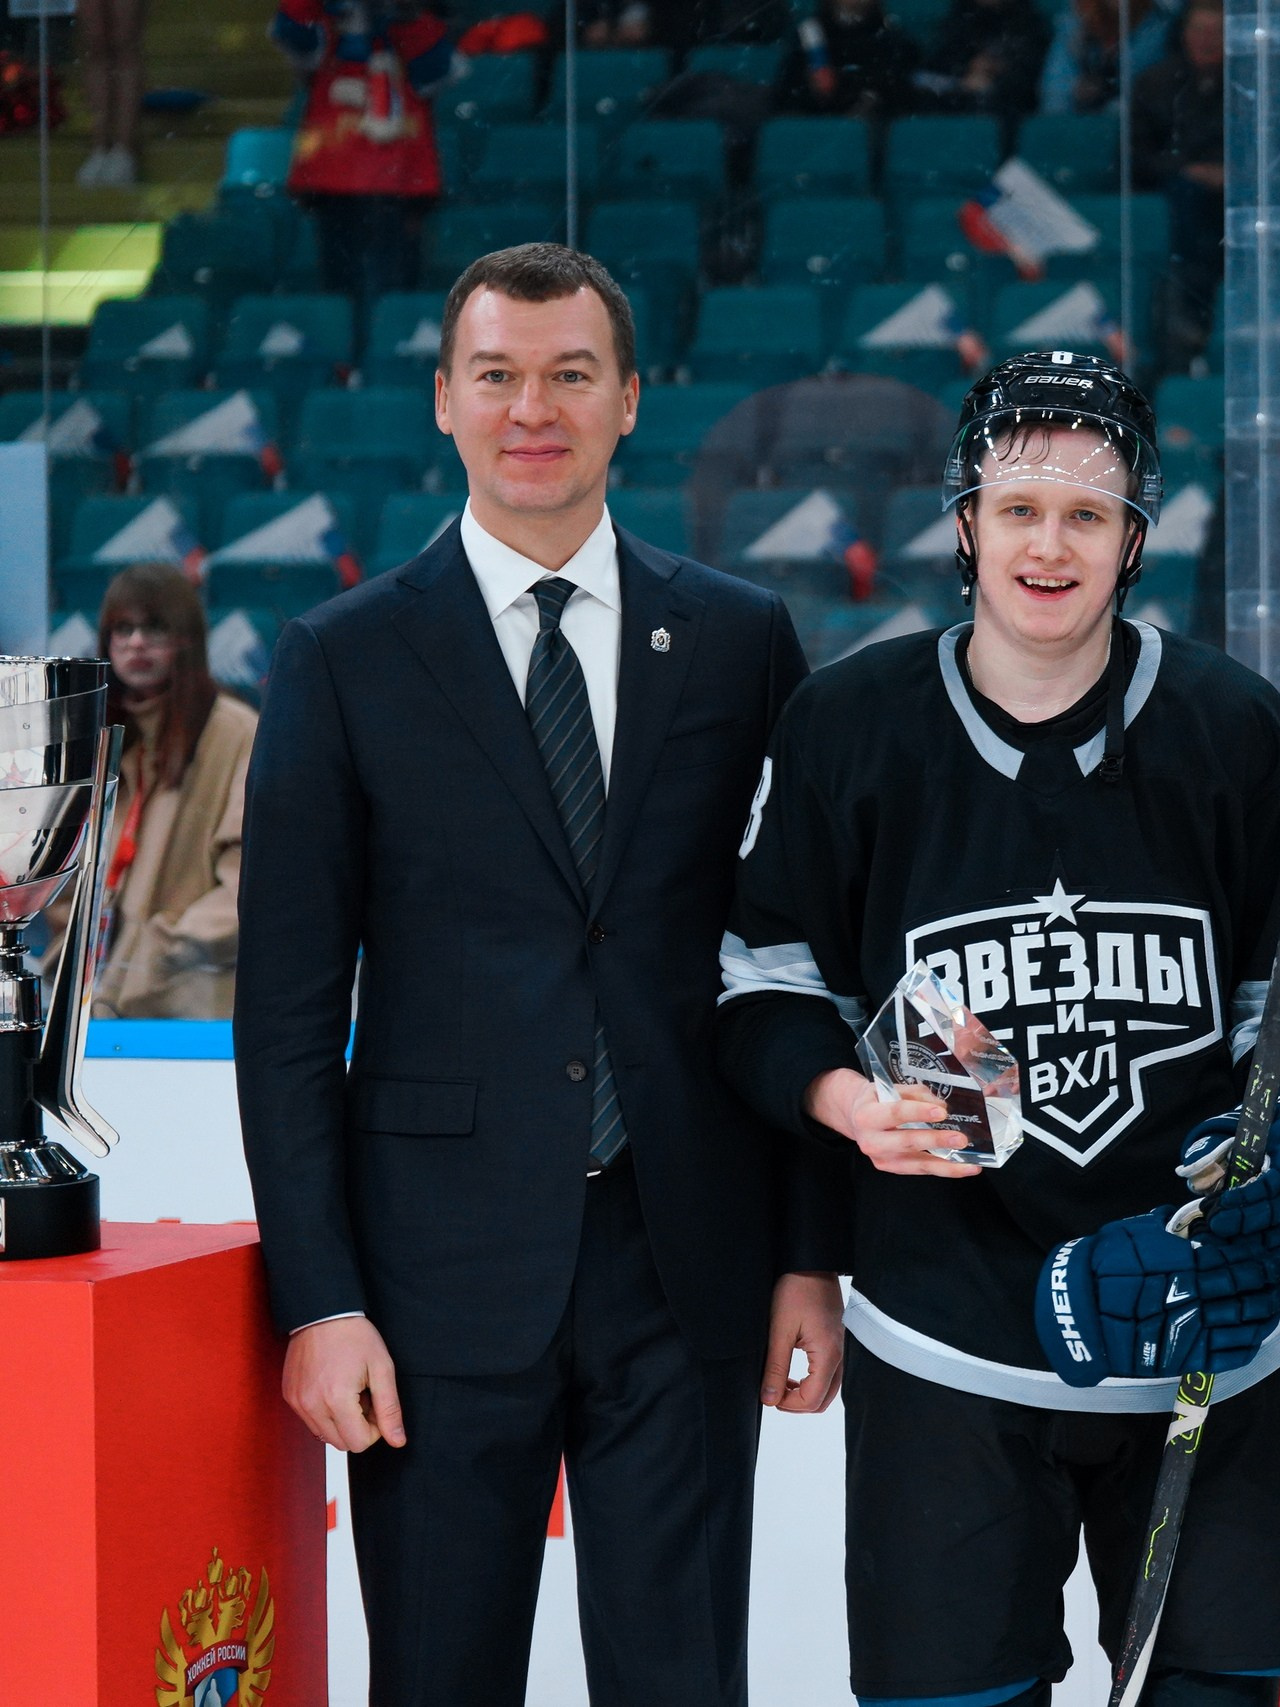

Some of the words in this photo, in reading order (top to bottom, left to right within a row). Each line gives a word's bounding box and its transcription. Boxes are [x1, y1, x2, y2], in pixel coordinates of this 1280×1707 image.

[1024, 375, 1094, 389] BAUER
[926, 921, 1202, 1014] ЗВЁЗДЫ
[1056, 1003, 1085, 1034] И
[1028, 1042, 1118, 1103] ВХЛ
[217, 1644, 246, 1662] РОССИИ
